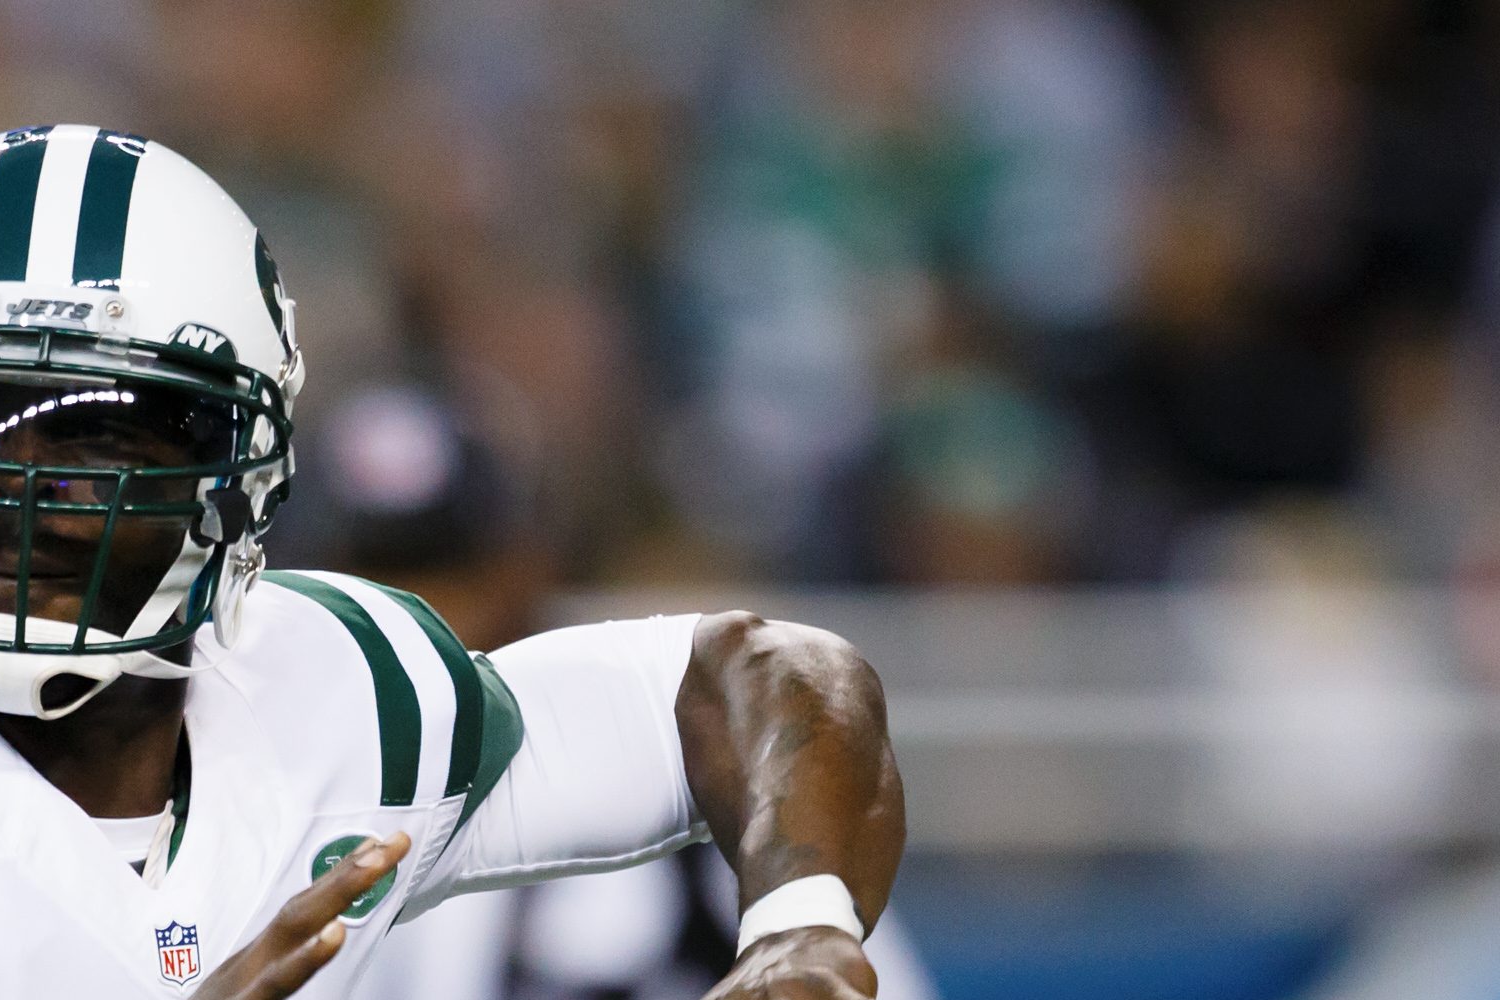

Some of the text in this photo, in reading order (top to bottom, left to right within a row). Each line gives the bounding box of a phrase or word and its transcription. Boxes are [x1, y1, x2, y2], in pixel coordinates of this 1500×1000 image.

[6, 298, 94, 320] JETS
[176, 323, 227, 354] NY
[162, 948, 198, 979] NFL
